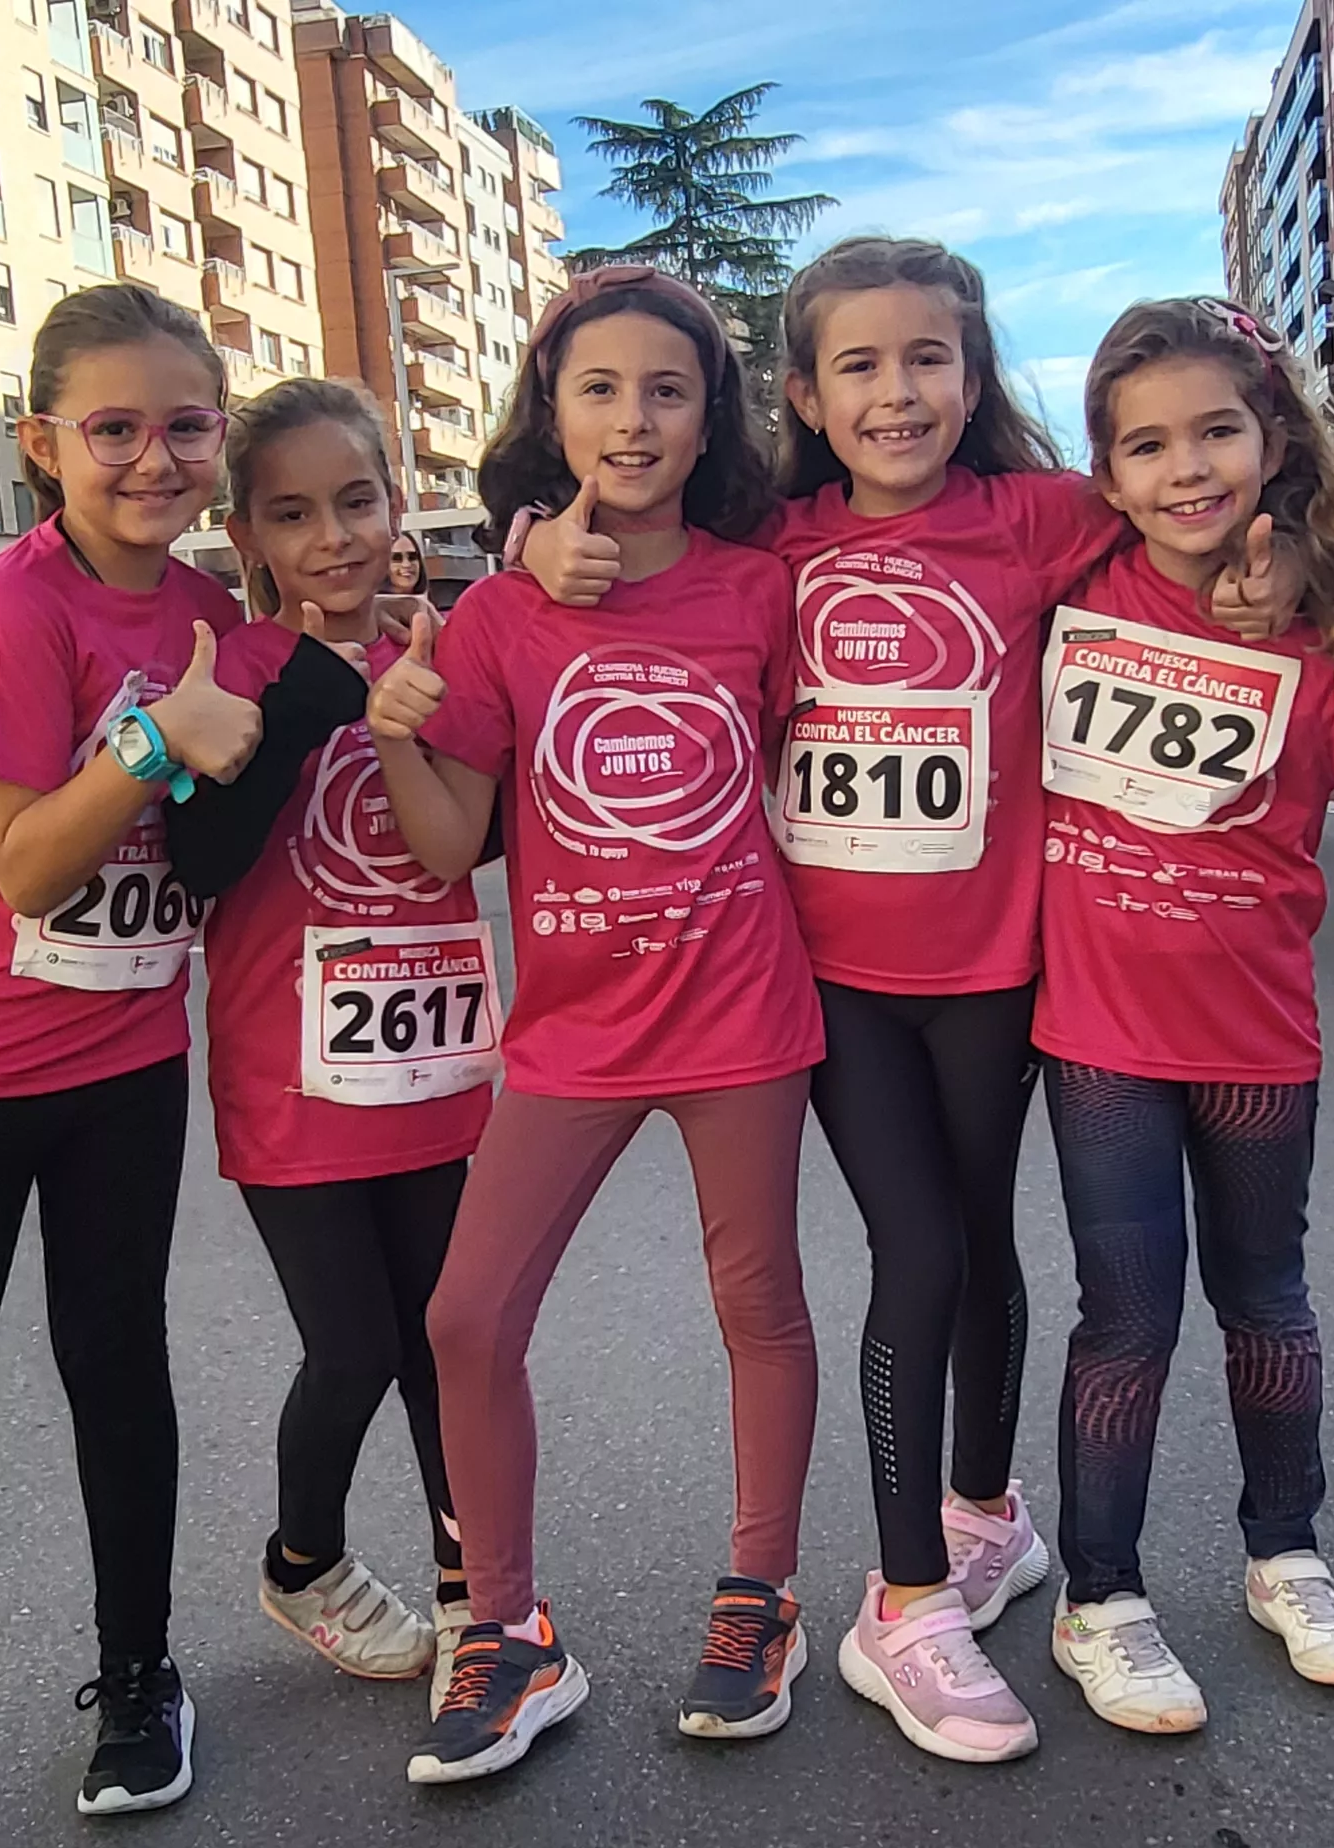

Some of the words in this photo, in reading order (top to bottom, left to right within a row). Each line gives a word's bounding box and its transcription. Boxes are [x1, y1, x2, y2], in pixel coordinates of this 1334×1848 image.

[830, 620, 906, 638] Caminemos
[834, 640, 900, 661] JUNTOS
[1141, 649, 1199, 673] HUESCA
[1075, 648, 1152, 682] CONTRA
[1155, 668, 1178, 688] EL
[1182, 673, 1264, 707] CÁNCER
[837, 709, 892, 724] HUESCA
[795, 723, 850, 741] CONTRA
[854, 725, 876, 742] EL
[880, 722, 960, 743] CÁNCER
[1064, 680, 1255, 783] 1782
[593, 734, 676, 754] Caminemos
[601, 751, 673, 776] JUNTOS
[793, 750, 962, 821] 1810
[711, 859, 744, 873] RBAN
[333, 961, 411, 979] CONTRA
[414, 961, 431, 976] EL
[327, 981, 485, 1055] 2617
